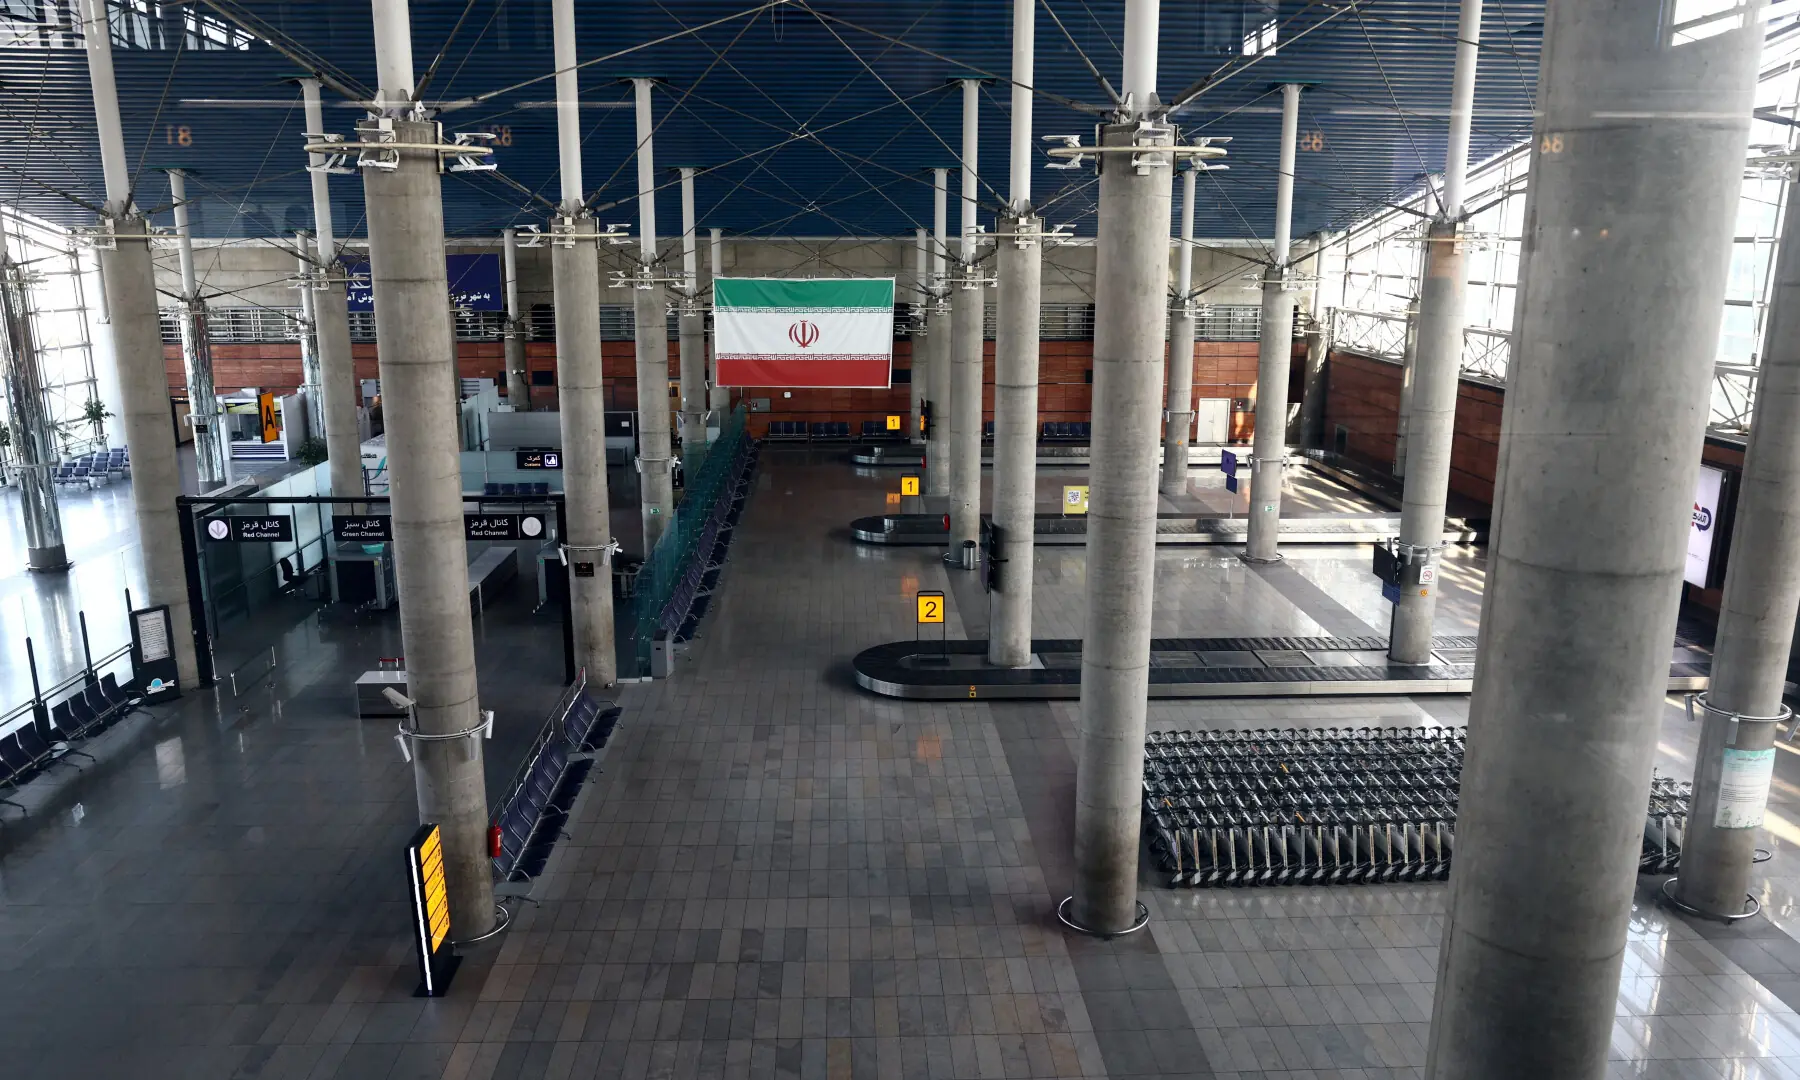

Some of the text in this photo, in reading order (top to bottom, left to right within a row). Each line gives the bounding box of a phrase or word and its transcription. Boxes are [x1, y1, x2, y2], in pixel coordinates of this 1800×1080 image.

[265, 405, 274, 431] A
[907, 480, 913, 493] 1
[241, 520, 280, 531] کانال قرمز
[344, 520, 381, 530] کانال سبز
[470, 519, 509, 529] کانال قرمز
[925, 601, 937, 618] 2
